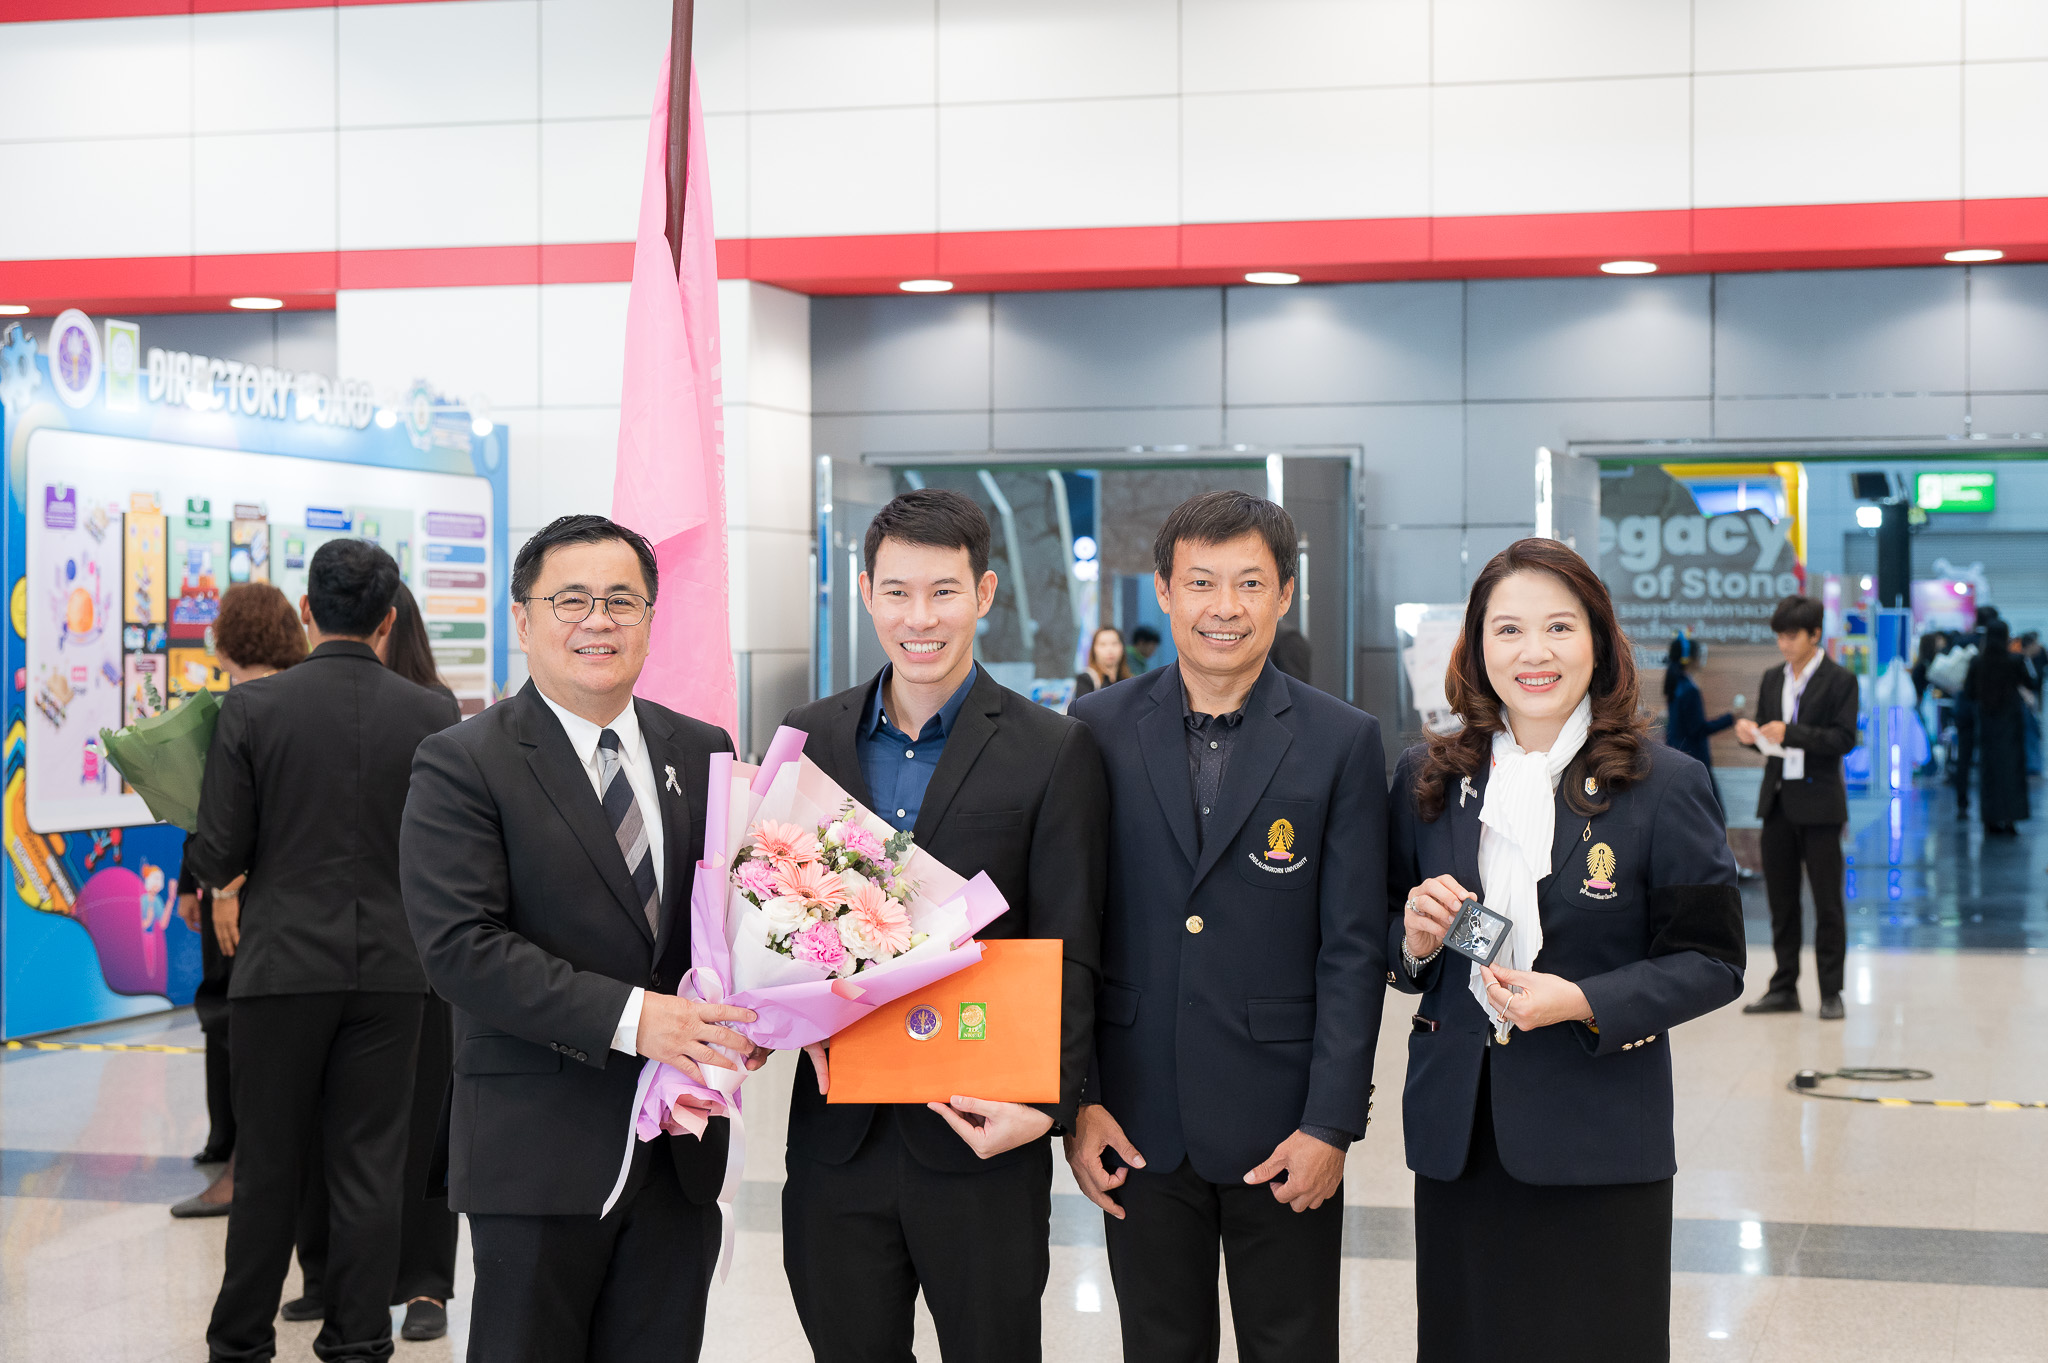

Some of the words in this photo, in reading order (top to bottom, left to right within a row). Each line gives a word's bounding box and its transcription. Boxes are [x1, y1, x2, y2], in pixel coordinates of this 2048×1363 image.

[1635, 566, 1674, 599] of
[1680, 566, 1799, 599] Stone
[1284, 856, 1308, 873] UNIVERSITY
